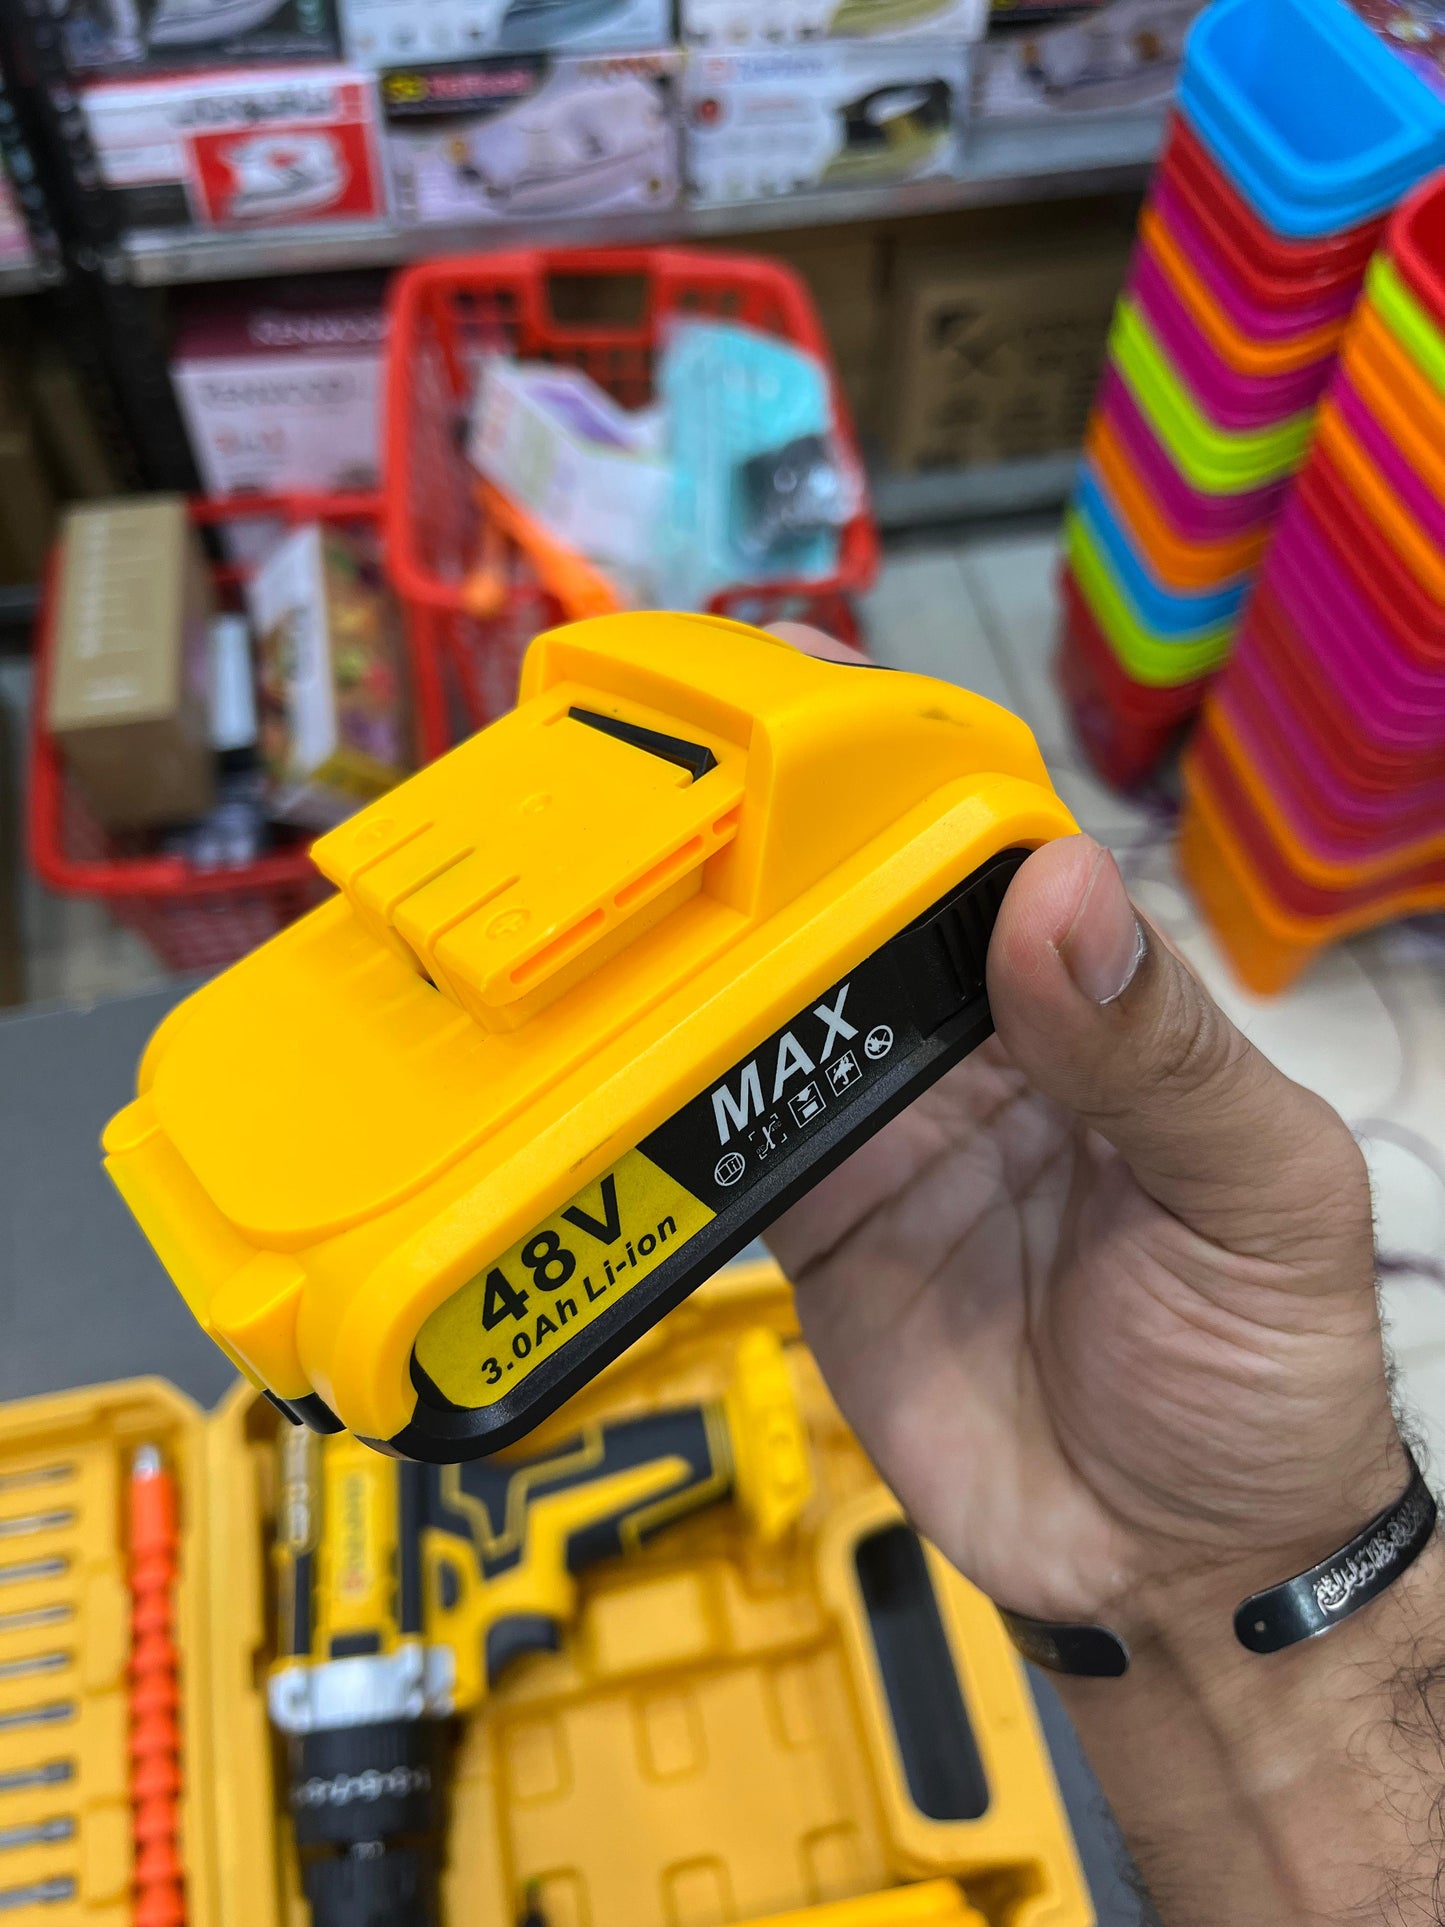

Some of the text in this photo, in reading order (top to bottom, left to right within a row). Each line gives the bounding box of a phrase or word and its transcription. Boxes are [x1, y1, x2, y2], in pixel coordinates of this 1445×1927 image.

[710, 983, 859, 1146] MAX
[480, 1173, 622, 1332] 48V
[480, 1214, 677, 1385] 3.0Ah Li-ion
